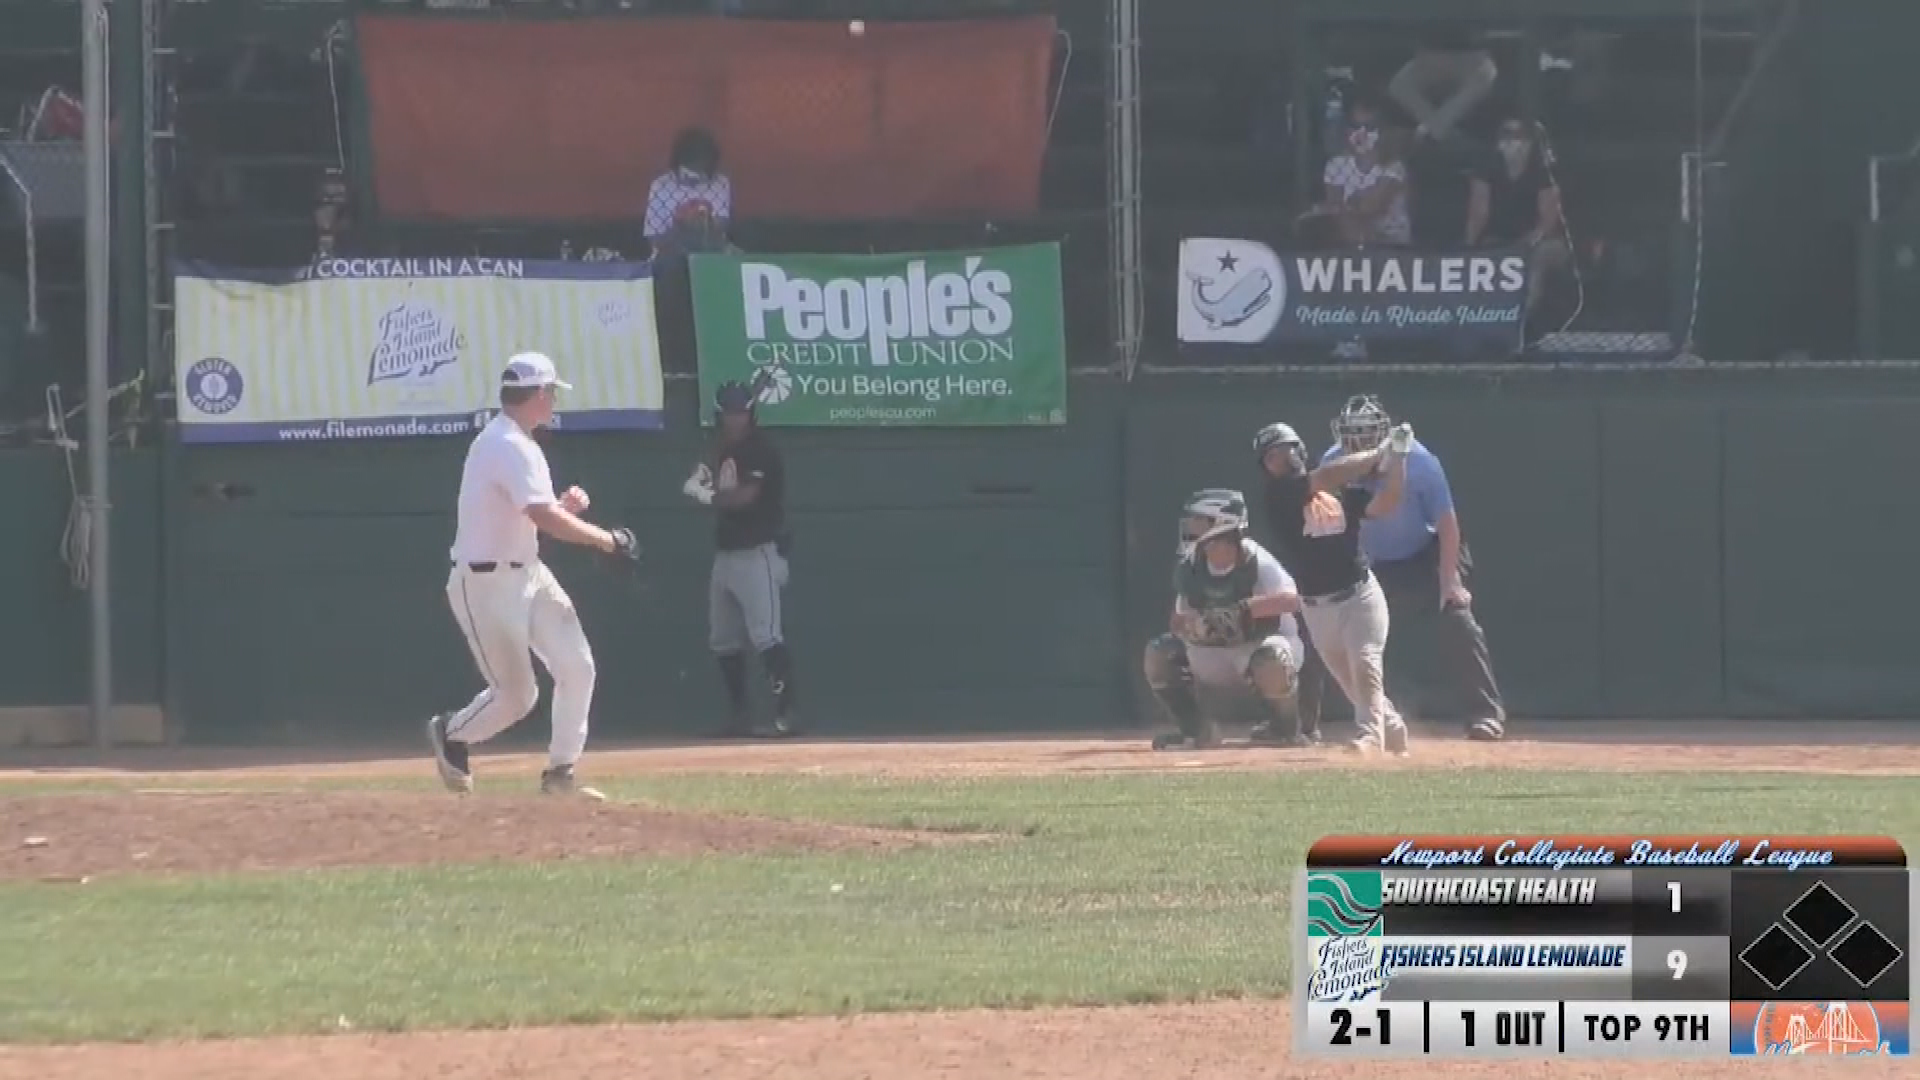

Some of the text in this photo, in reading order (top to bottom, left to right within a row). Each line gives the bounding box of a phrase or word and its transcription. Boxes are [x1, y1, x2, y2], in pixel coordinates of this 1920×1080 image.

[316, 258, 424, 278] COCKTAIL
[429, 258, 452, 276] IN
[457, 259, 475, 276] A
[478, 258, 524, 277] CAN
[1296, 257, 1525, 293] WHALERS
[741, 256, 1013, 366] People's
[1296, 304, 1520, 327] Made in Rhode Island
[746, 338, 1014, 367] CREDIT UNION
[796, 374, 1013, 401] You Belong Here.
[829, 405, 937, 421] peoplescu.com
[278, 417, 470, 441] www.filemonade.com
